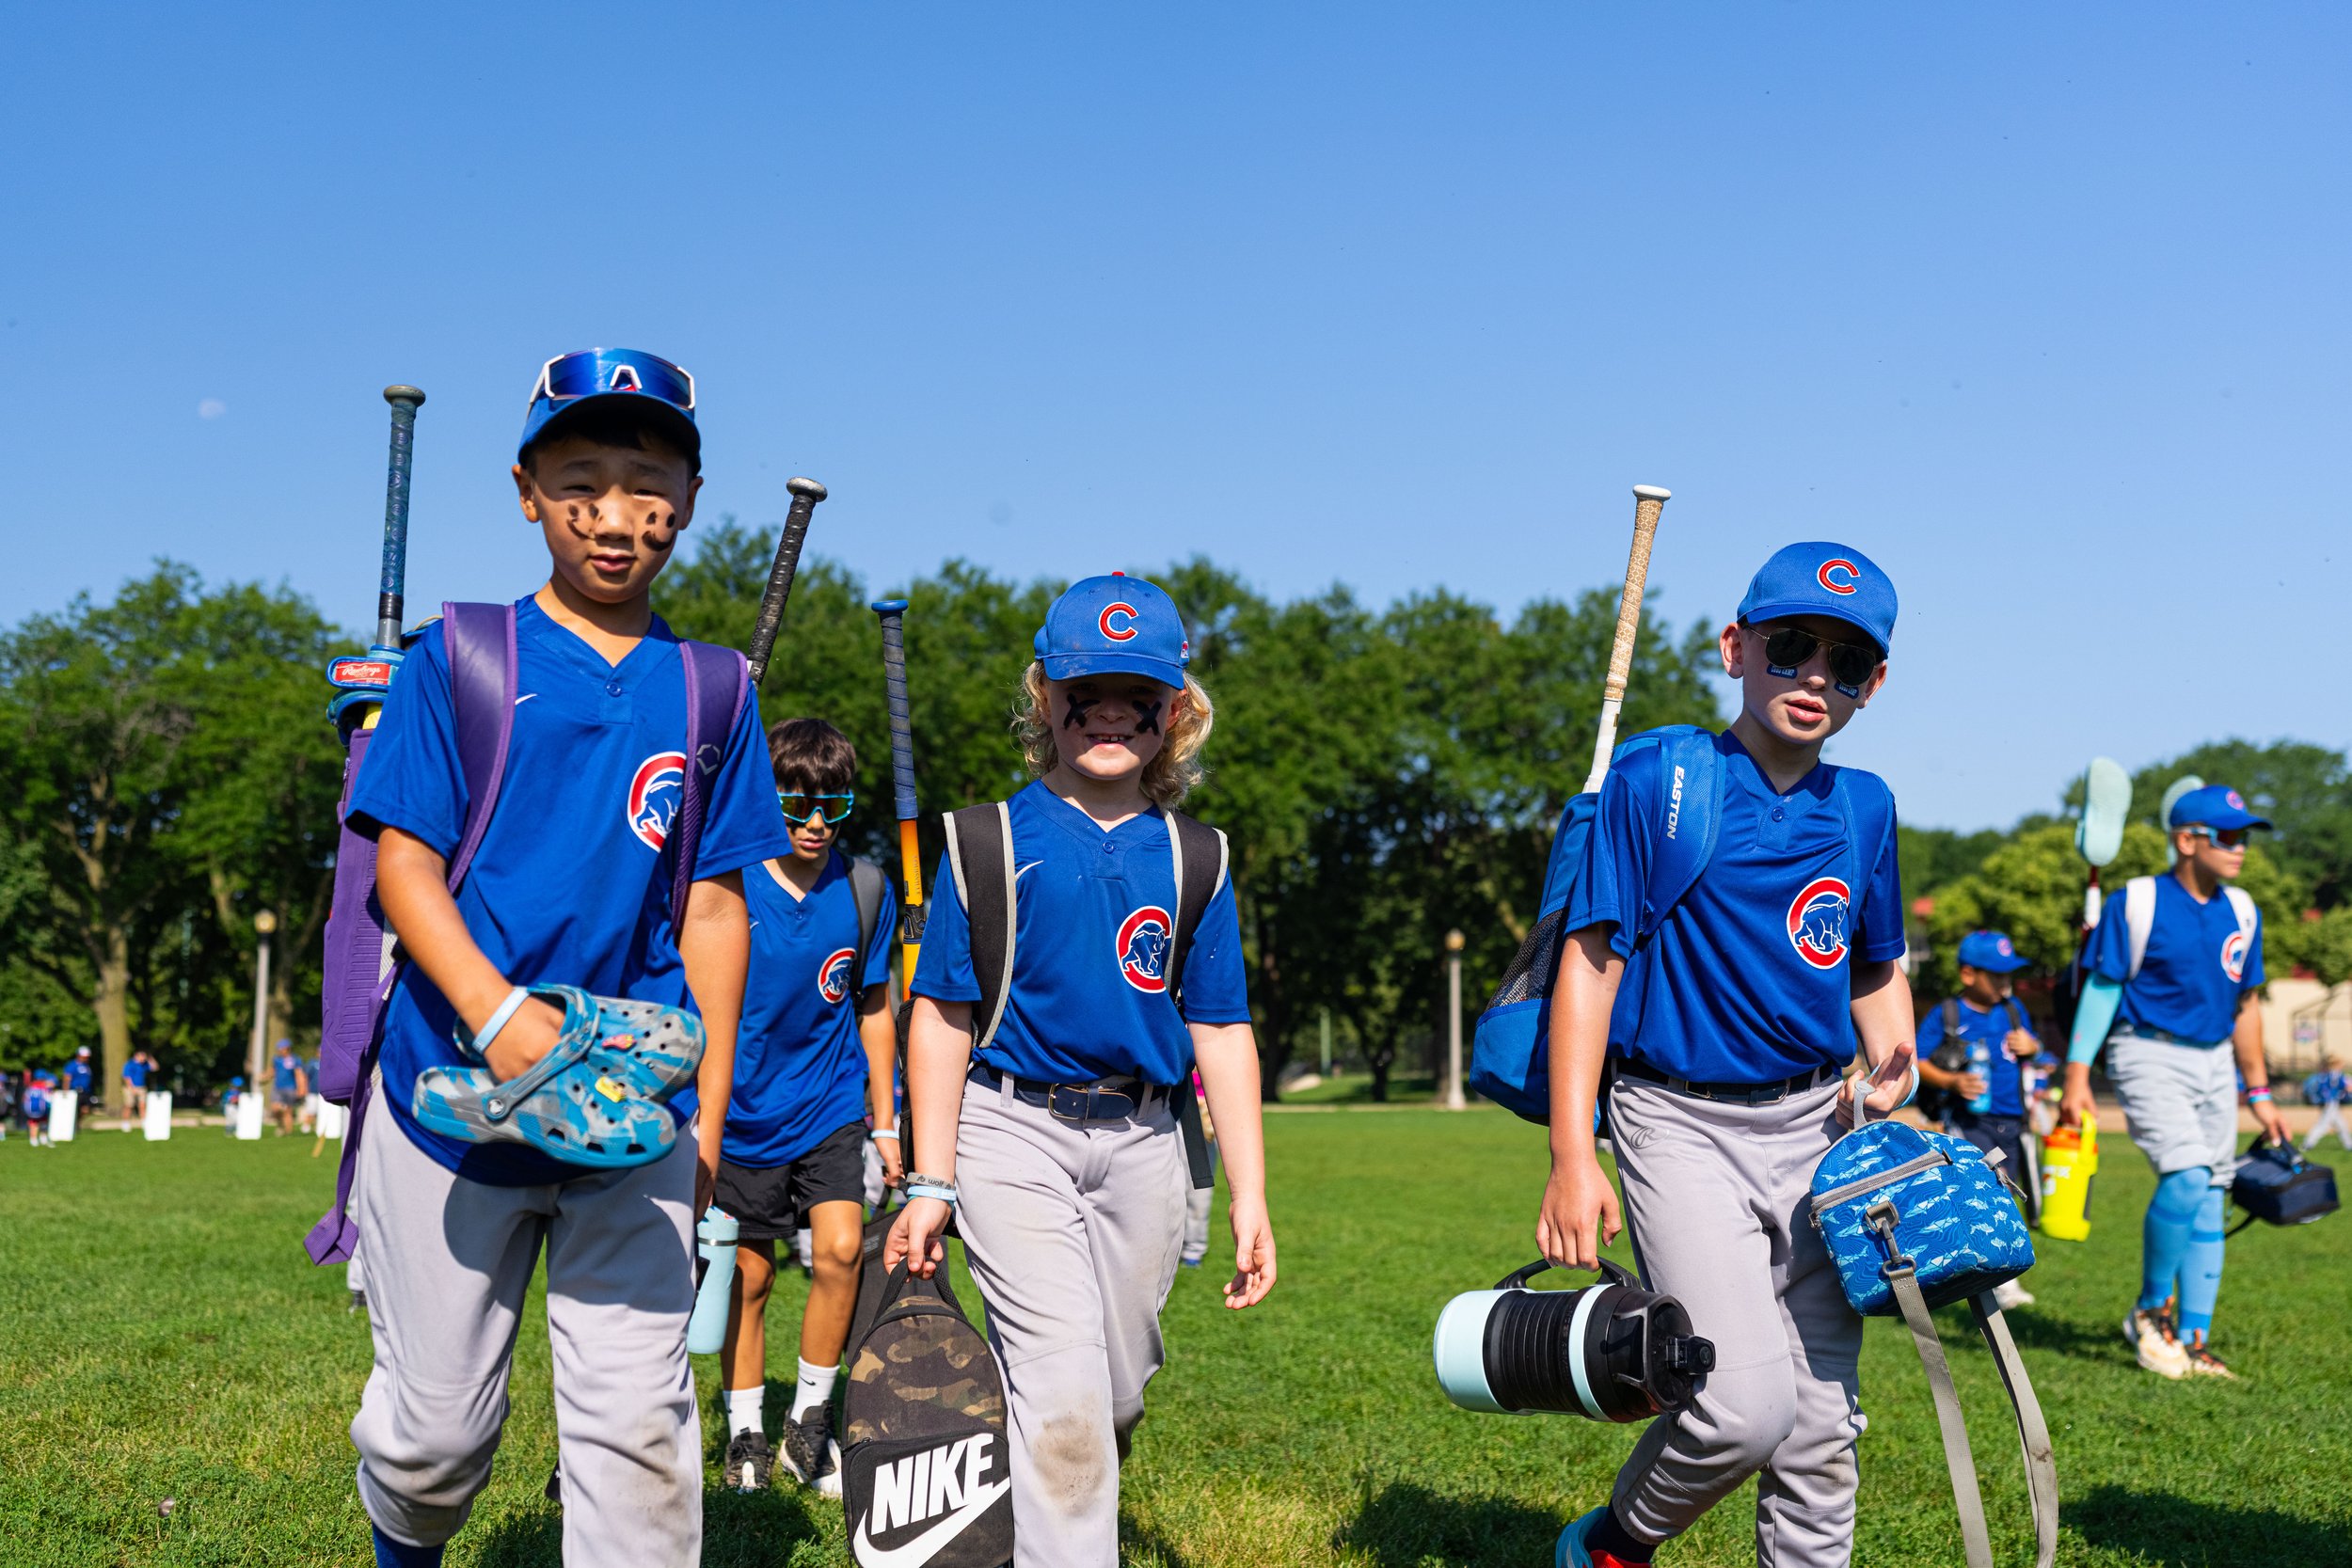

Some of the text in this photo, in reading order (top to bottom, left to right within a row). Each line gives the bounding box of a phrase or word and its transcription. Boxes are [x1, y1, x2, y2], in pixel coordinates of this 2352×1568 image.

[1817, 559, 1861, 595] C
[1099, 602, 1138, 641] C
[1667, 765, 1685, 840] EASTON
[928, 1178, 945, 1187] wolf
[871, 1433, 993, 1535] NIKE
